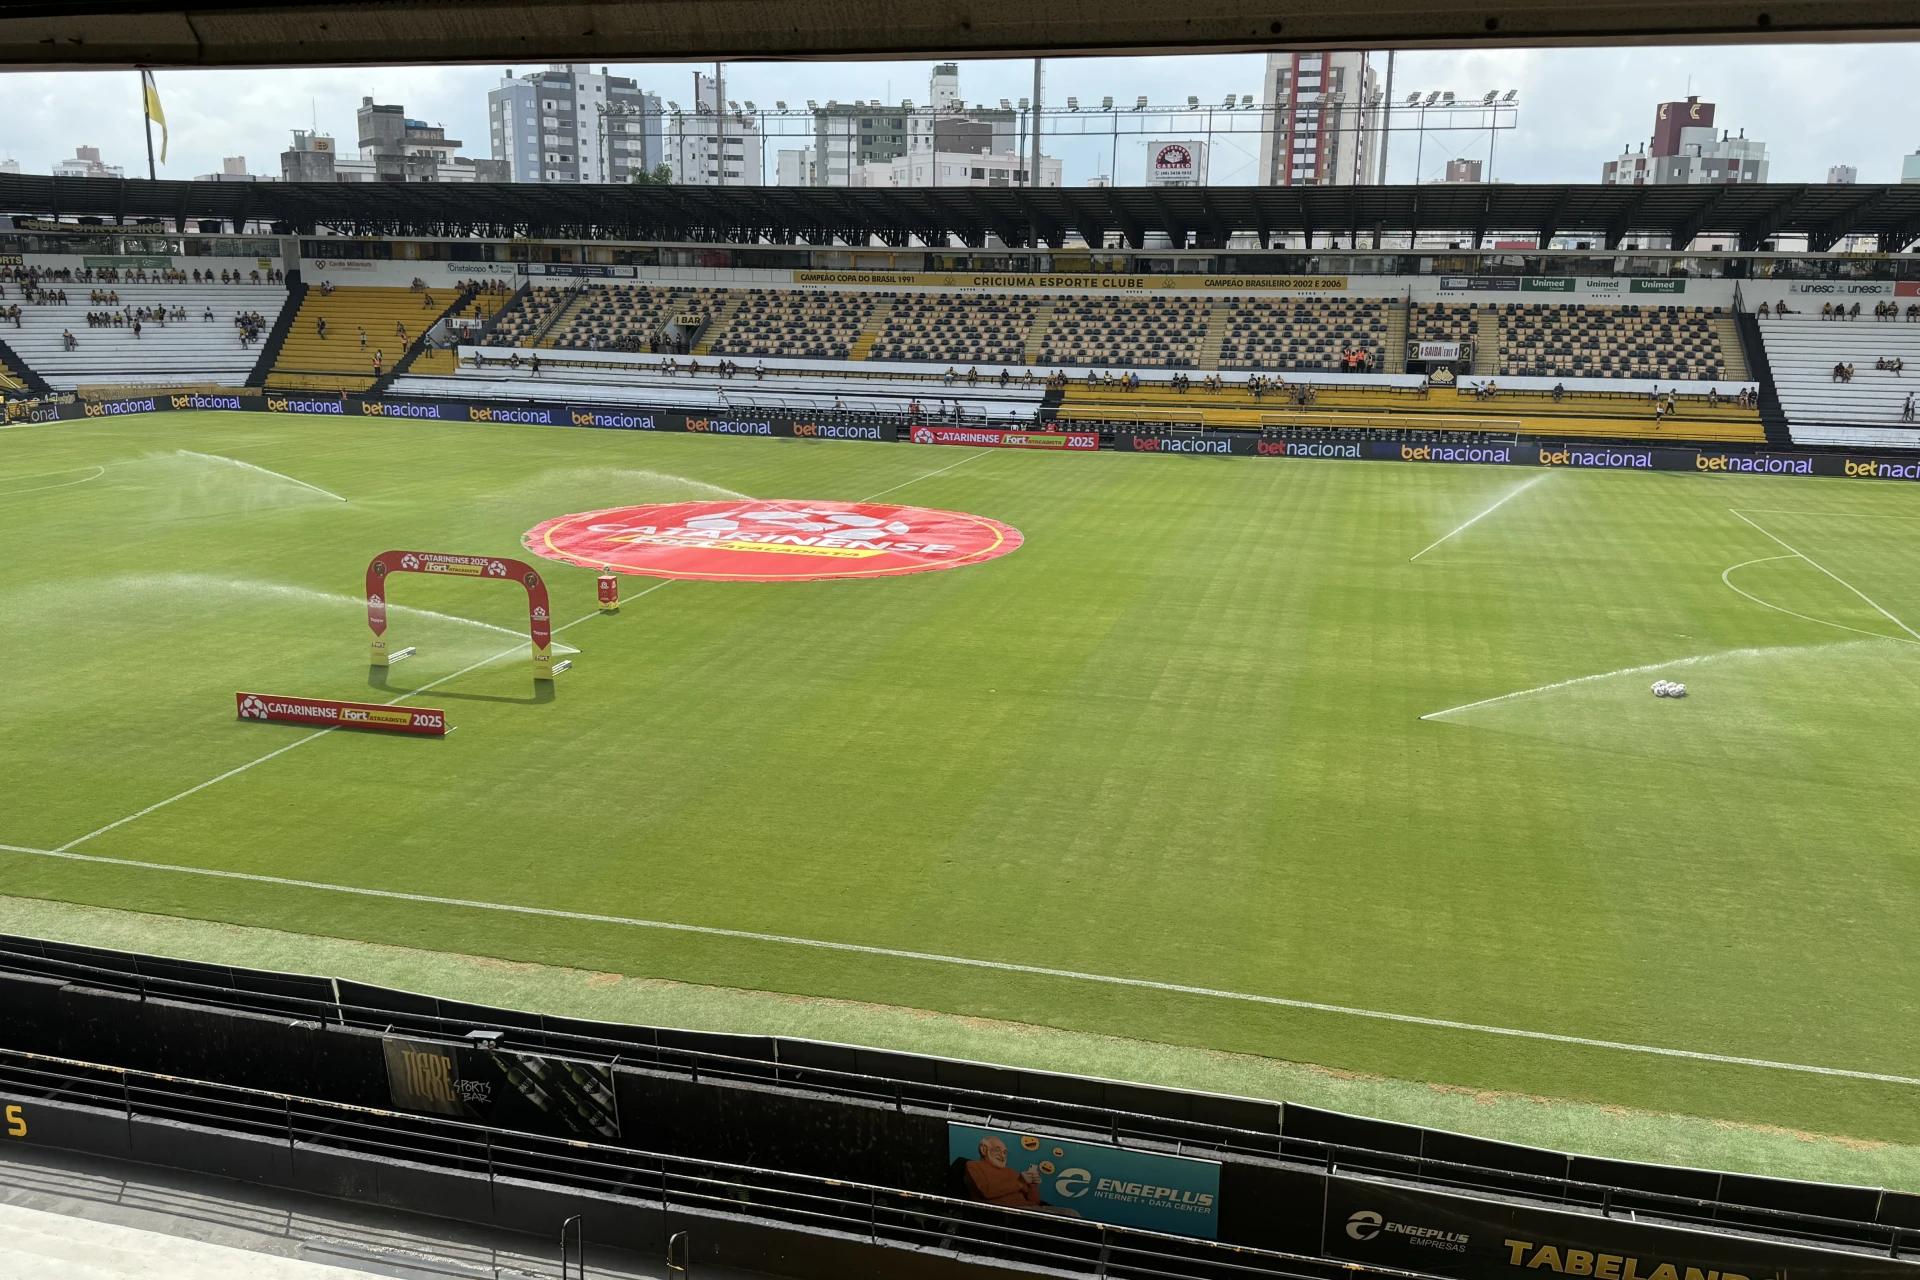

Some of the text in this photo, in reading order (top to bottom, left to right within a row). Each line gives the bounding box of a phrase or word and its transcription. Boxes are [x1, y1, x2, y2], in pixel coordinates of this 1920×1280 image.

[837, 274, 857, 282] COPA
[872, 275, 896, 283] BRASIL
[1040, 277, 1098, 287] ESPORTE
[1102, 278, 1144, 287] CLUBE
[1245, 279, 1291, 287] BRASILEIRO
[1532, 279, 1565, 287] Unimed
[1586, 280, 1619, 288] Unimed
[1800, 284, 1835, 293] unesc
[1847, 284, 1882, 294] unesc
[84, 398, 156, 417] betnacional
[171, 394, 241, 410] betnacional
[267, 397, 344, 414] betnacional
[362, 401, 440, 418] betnacional
[469, 406, 552, 424] betnacional
[571, 411, 655, 429] betnacional
[686, 416, 772, 435] betnacional
[793, 421, 881, 440] betnacional
[936, 432, 999, 443] CATARINENSE
[1006, 435, 1027, 444] Fort
[1067, 436, 1095, 448] 2025
[1133, 435, 1232, 453] betnacional
[1257, 439, 1361, 458] betnacional
[1401, 444, 1511, 462] betnacional
[1538, 448, 1652, 468] betnacional
[1695, 453, 1813, 474] betnacional
[587, 524, 957, 554] CATARINENSE
[418, 554, 489, 566] CATARINENSE 2025
[429, 563, 448, 571] Fort
[268, 702, 338, 718] CATARINENSE
[344, 708, 368, 720] Fort
[413, 714, 442, 728] 2025
[453, 1079, 492, 1094] SPORTS
[461, 1092, 492, 1103] BAR
[1096, 1178, 1214, 1207] ENGEPLUS
[1094, 1190, 1211, 1214] INTERNET DATA CENTER
[1384, 1221, 1470, 1244] ENGEPLUS
[1409, 1236, 1466, 1253] EMPRESAS
